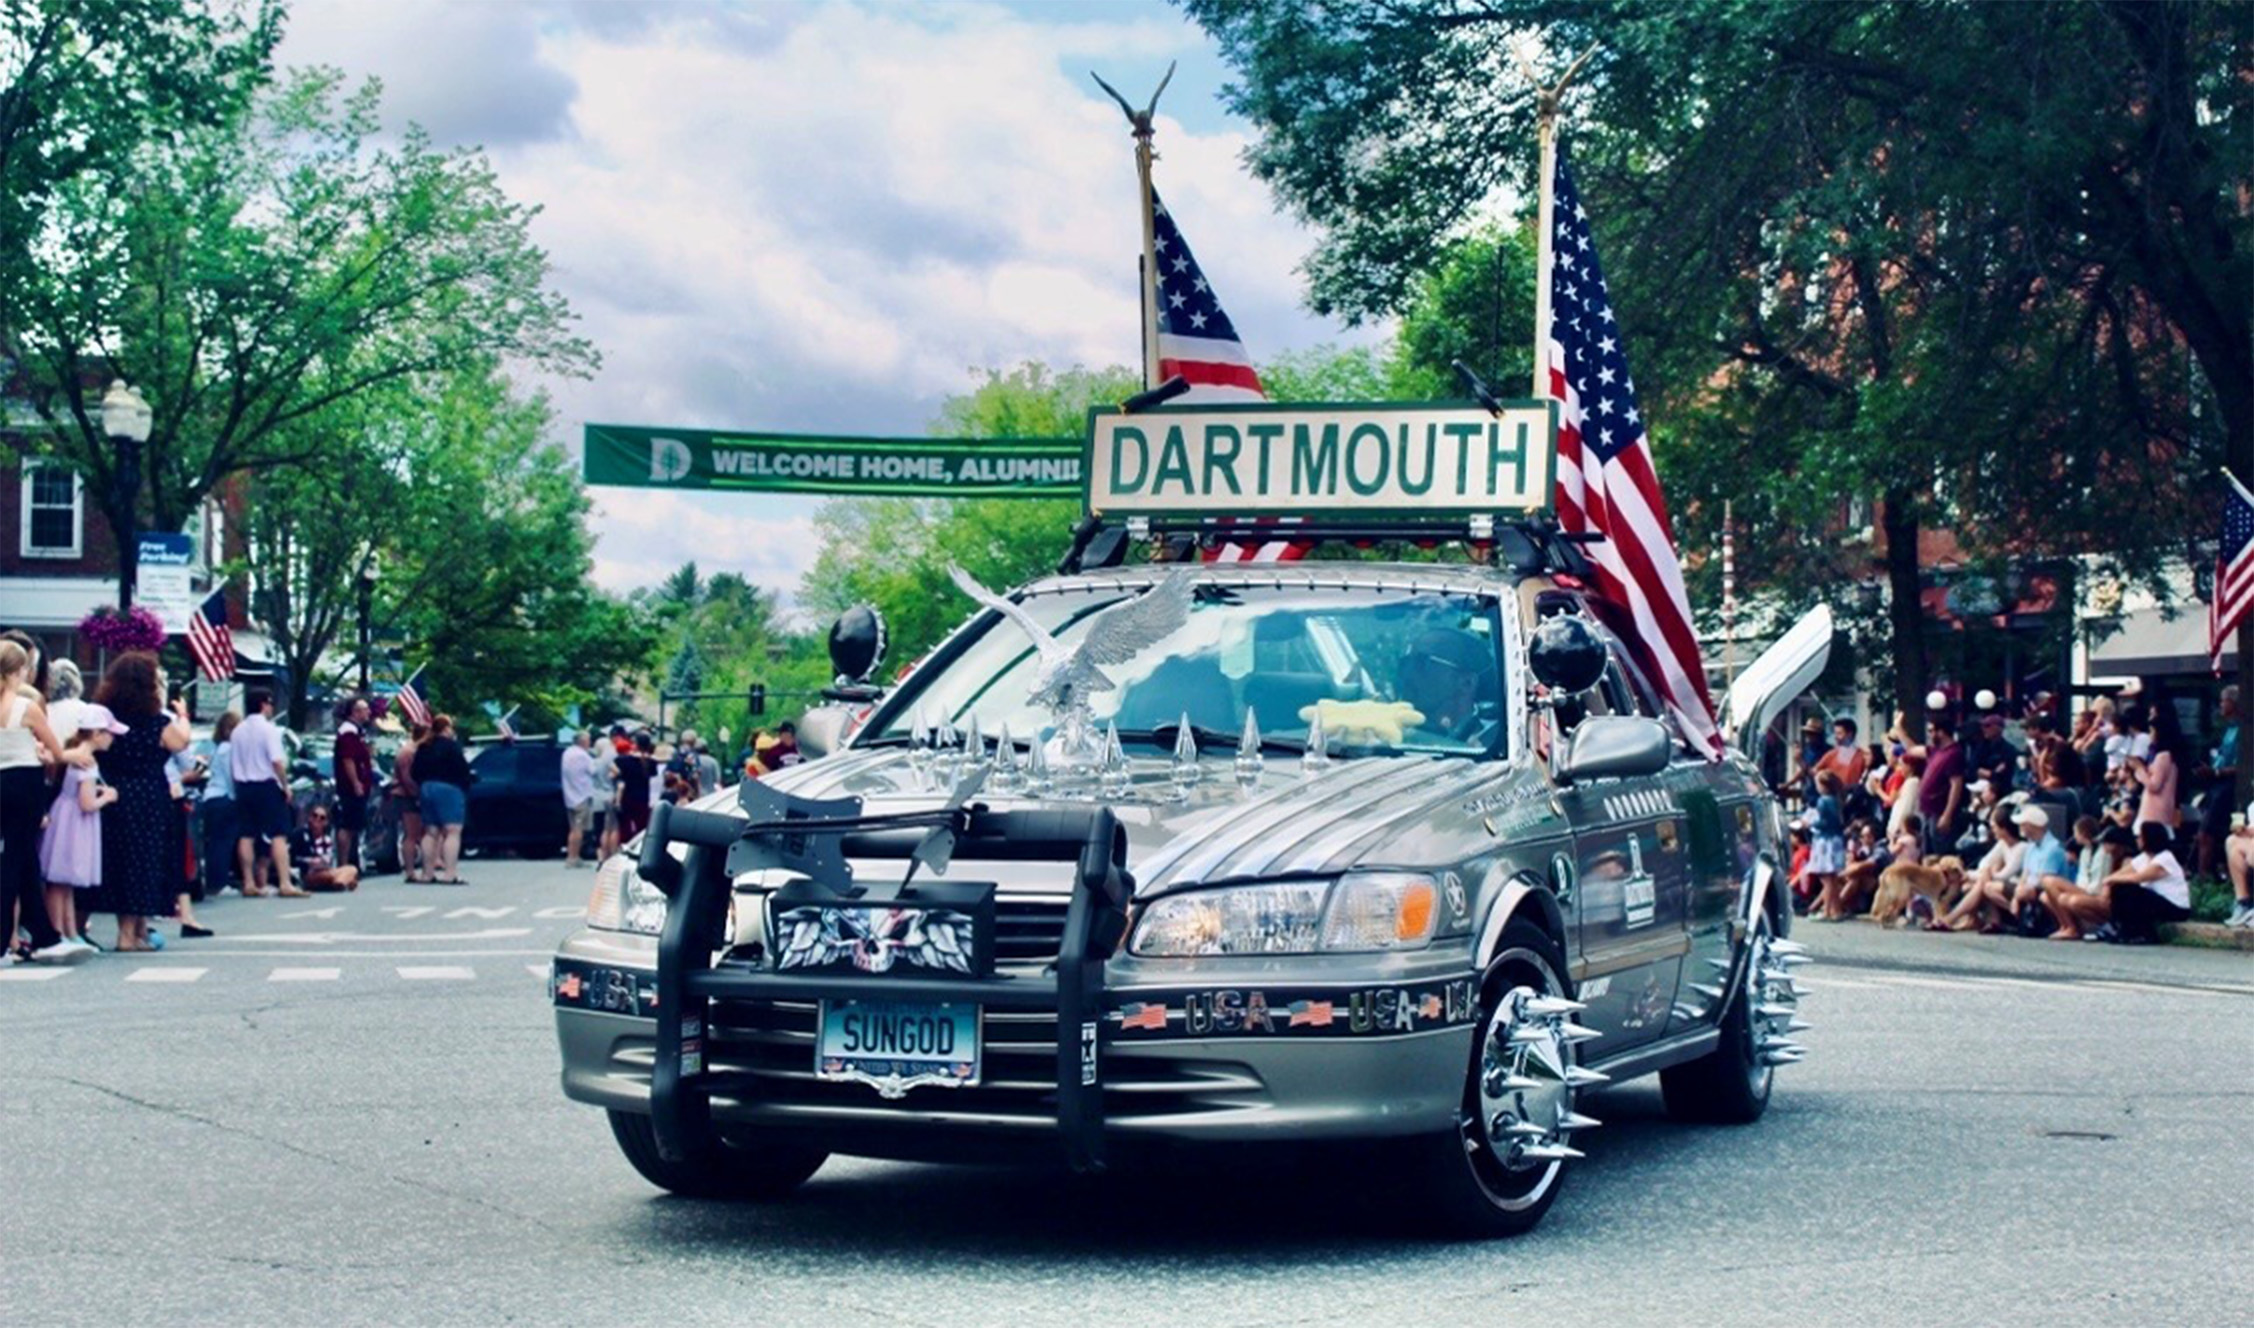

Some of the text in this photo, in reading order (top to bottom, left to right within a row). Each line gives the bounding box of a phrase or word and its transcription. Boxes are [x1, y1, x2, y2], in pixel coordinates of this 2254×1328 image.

[712, 450, 1081, 483] WELCOME HOME, ALUMNI!
[1109, 422, 1529, 496] DARTMOUTH
[1185, 990, 1275, 1034] USA
[1350, 989, 1413, 1031] USA
[843, 1014, 955, 1055] SUNGOD
